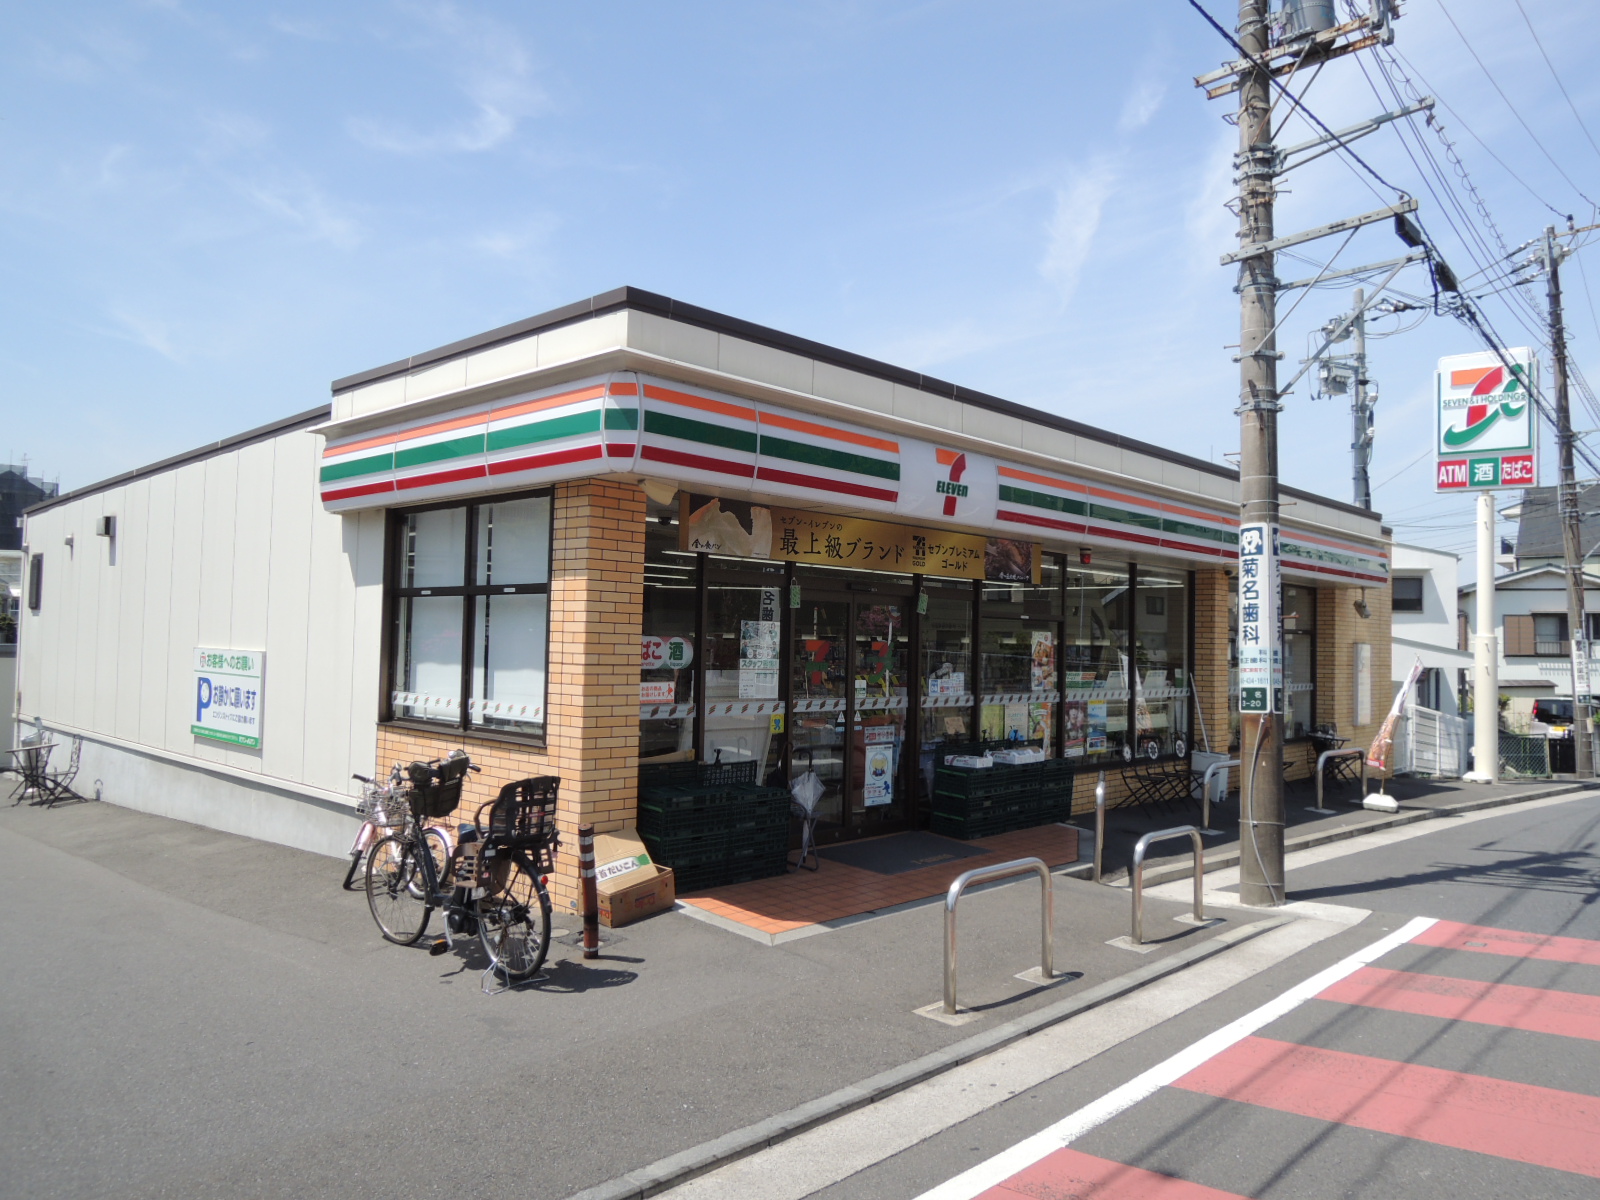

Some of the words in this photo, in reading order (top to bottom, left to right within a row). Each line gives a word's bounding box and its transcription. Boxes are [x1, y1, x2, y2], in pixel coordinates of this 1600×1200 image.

[1481, 392, 1526, 403] HOLDINGS
[1439, 465, 1466, 483] ATM
[1474, 463, 1494, 481] 酒
[1502, 462, 1532, 479] たばこ
[780, 528, 904, 564] 最上級ブランド
[927, 544, 980, 559] セブンプレミアム
[942, 559, 968, 571] ゴールド
[1242, 558, 1260, 645] 菊名歯科
[641, 640, 662, 660] ばこ
[669, 641, 683, 660] 酒
[206, 653, 254, 671] お客様へのお願い
[597, 861, 638, 879] 首だいこん
